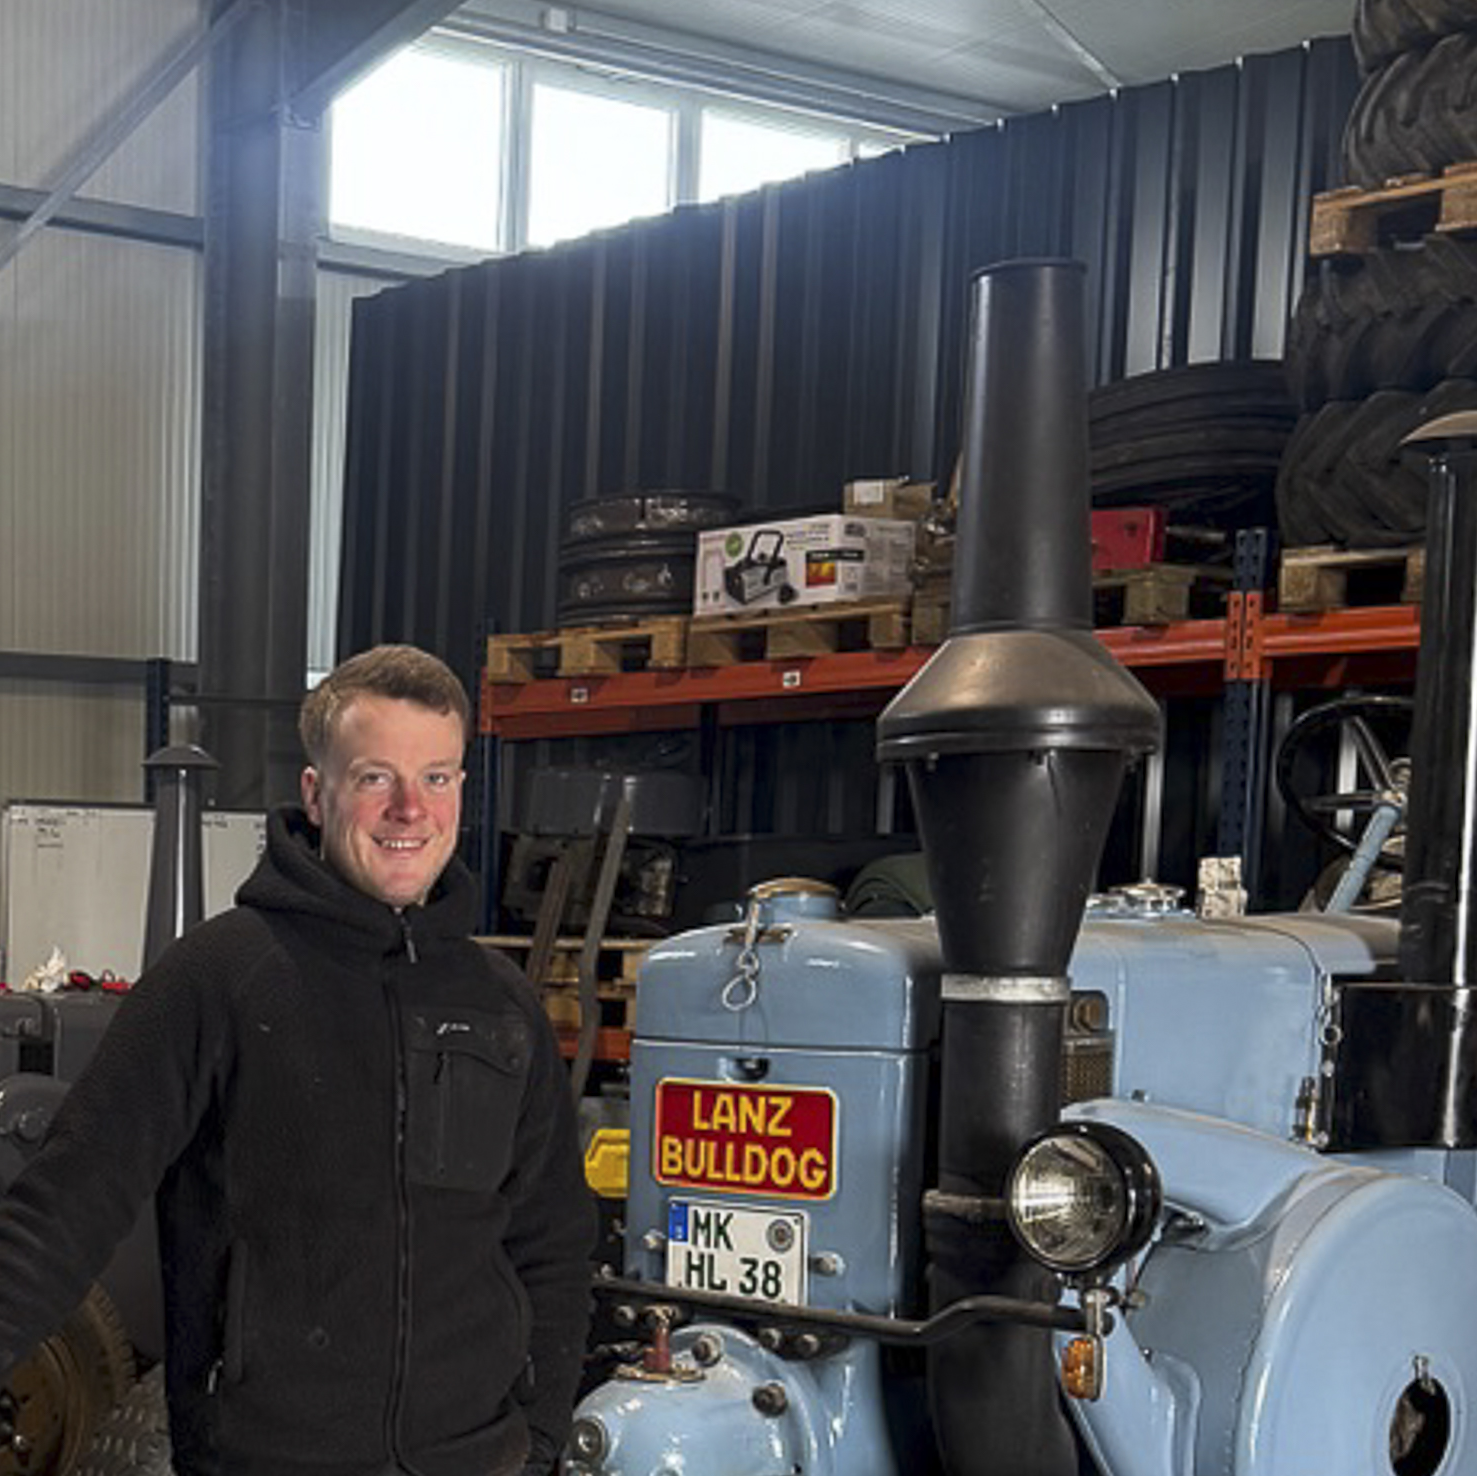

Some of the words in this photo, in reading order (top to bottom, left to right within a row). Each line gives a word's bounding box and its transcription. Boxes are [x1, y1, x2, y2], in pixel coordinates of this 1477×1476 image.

[692, 1090, 793, 1137] LANZ
[661, 1134, 827, 1190] BULLDOG
[692, 1208, 734, 1252] MK
[685, 1250, 728, 1291] HL
[738, 1257, 782, 1299] 38
